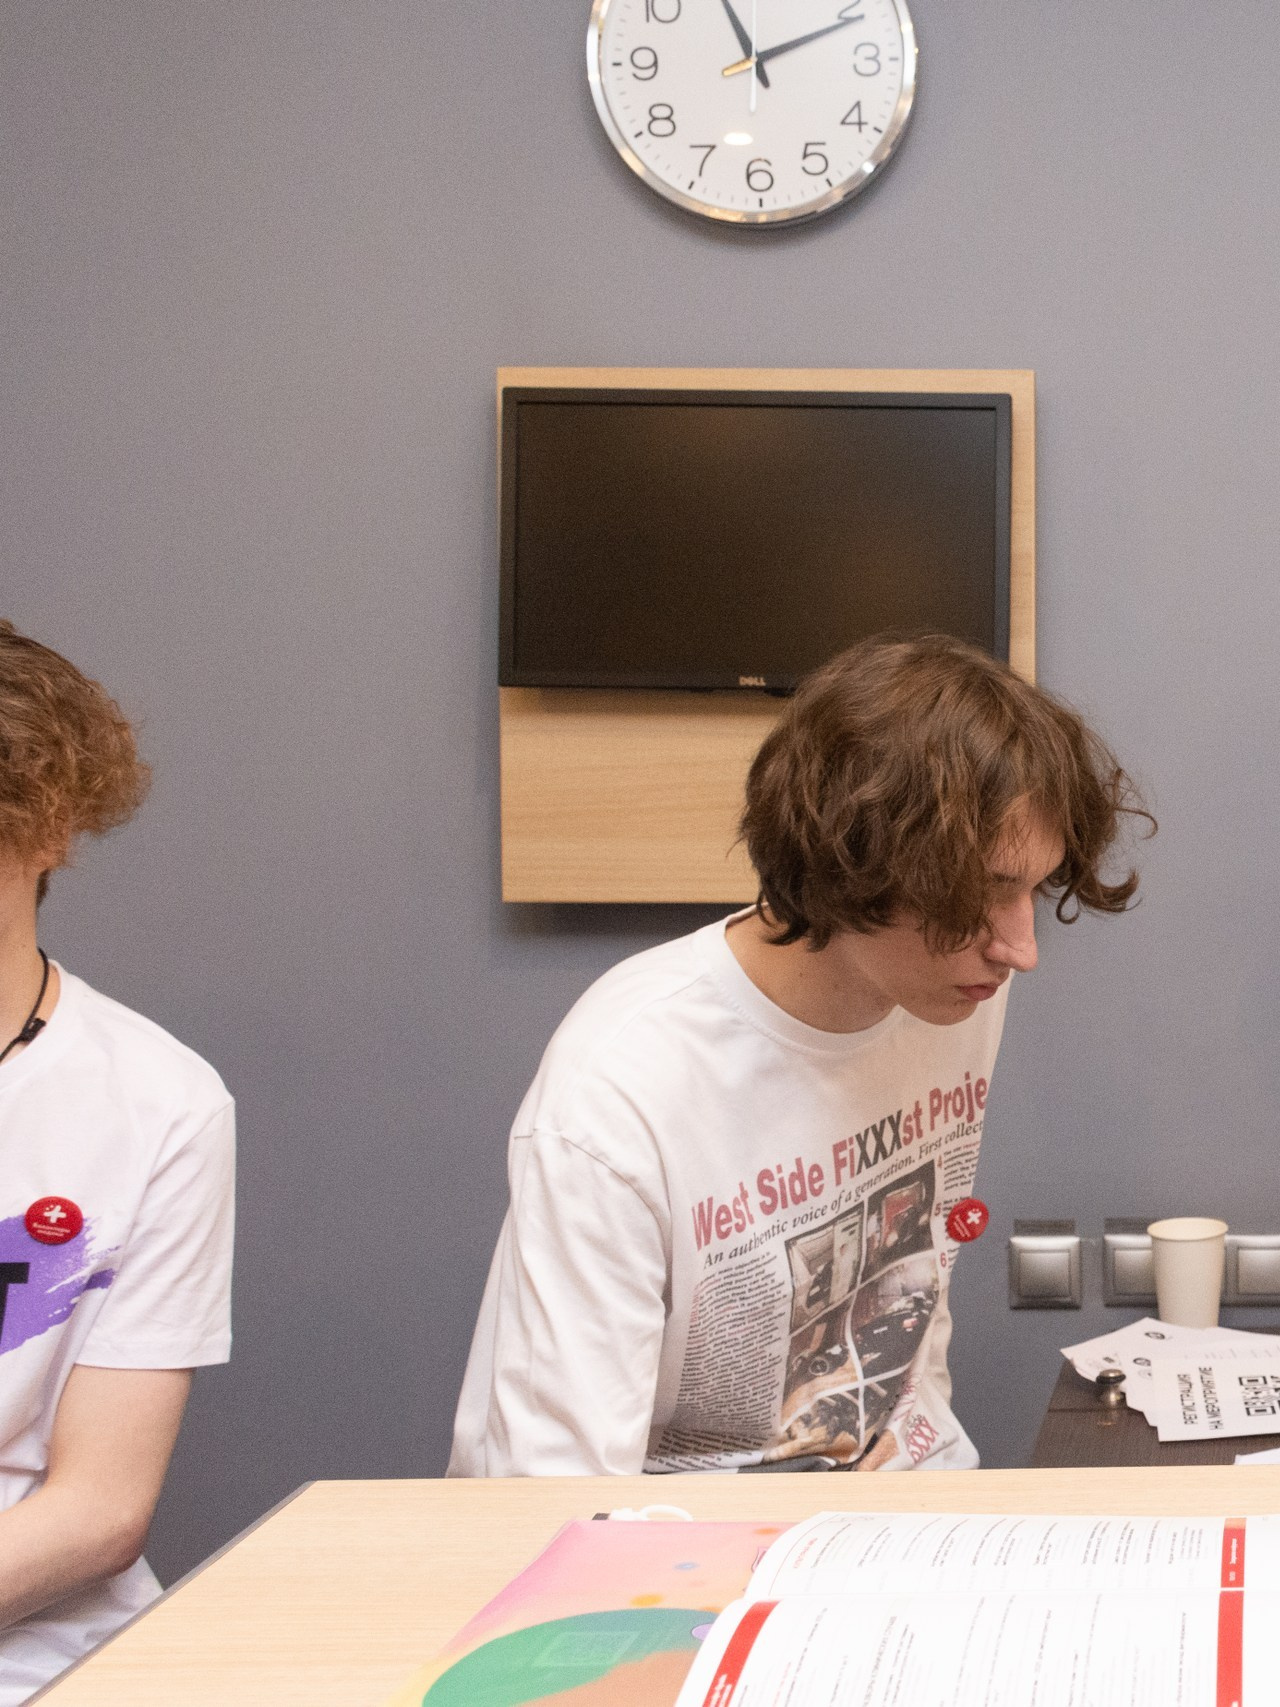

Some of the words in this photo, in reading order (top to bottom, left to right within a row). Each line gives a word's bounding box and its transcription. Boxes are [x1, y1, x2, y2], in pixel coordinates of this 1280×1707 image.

[629, 46, 659, 81] 9
[852, 42, 881, 77] 3
[647, 103, 676, 137] 8
[839, 100, 868, 133] 4
[689, 144, 717, 177] 7
[745, 158, 774, 192] 6
[801, 141, 829, 176] 5
[692, 1180, 755, 1252] West
[756, 1156, 825, 1216] Side
[704, 1250, 724, 1270] An
[728, 1219, 788, 1259] authentic
[792, 1206, 828, 1228] voice
[830, 1189, 846, 1214] of
[853, 1155, 916, 1203] generation.
[917, 1136, 942, 1160] First
